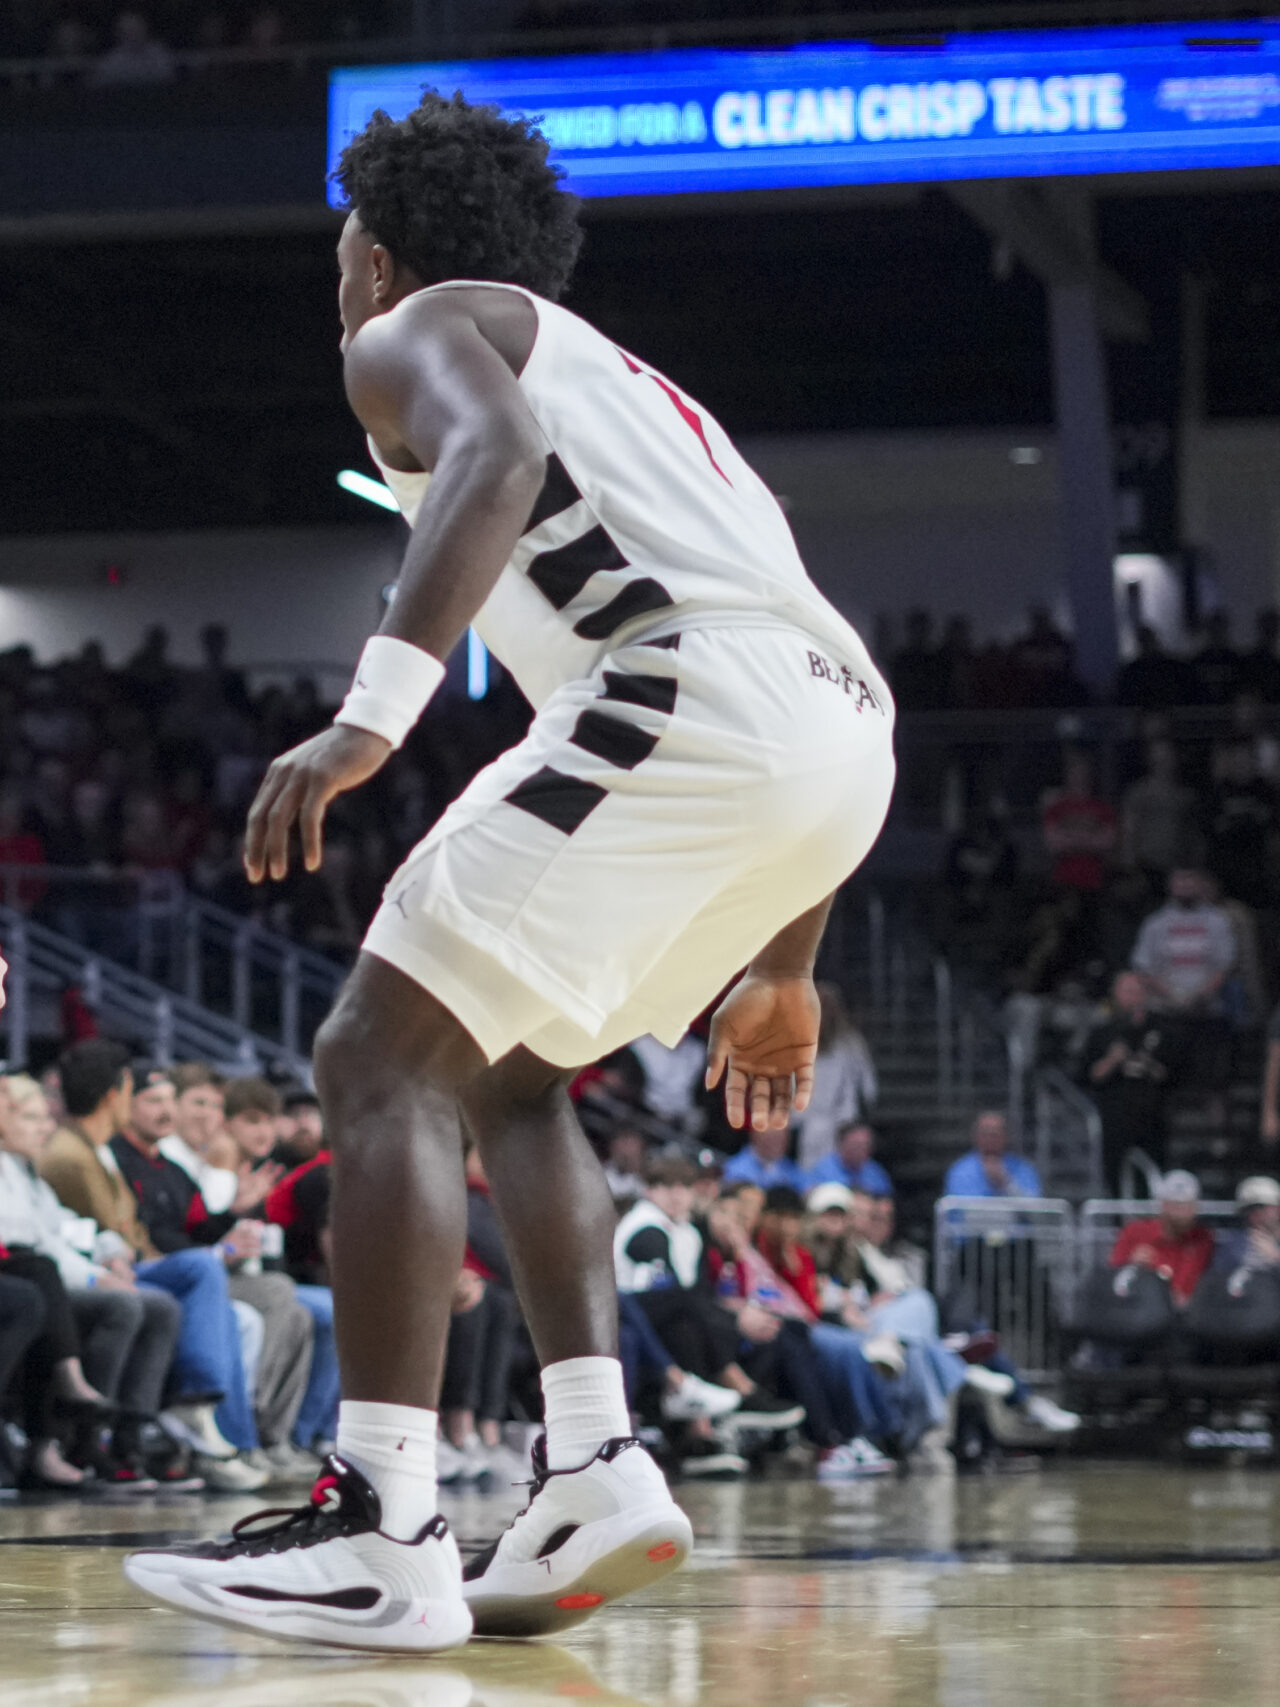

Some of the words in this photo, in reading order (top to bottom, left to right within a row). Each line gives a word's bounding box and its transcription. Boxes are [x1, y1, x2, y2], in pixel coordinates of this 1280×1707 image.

[619, 102, 682, 147] FOR
[682, 101, 708, 144] A
[713, 86, 857, 149] CLEAN
[858, 80, 985, 141] CRISP
[987, 73, 1125, 134] TASTE
